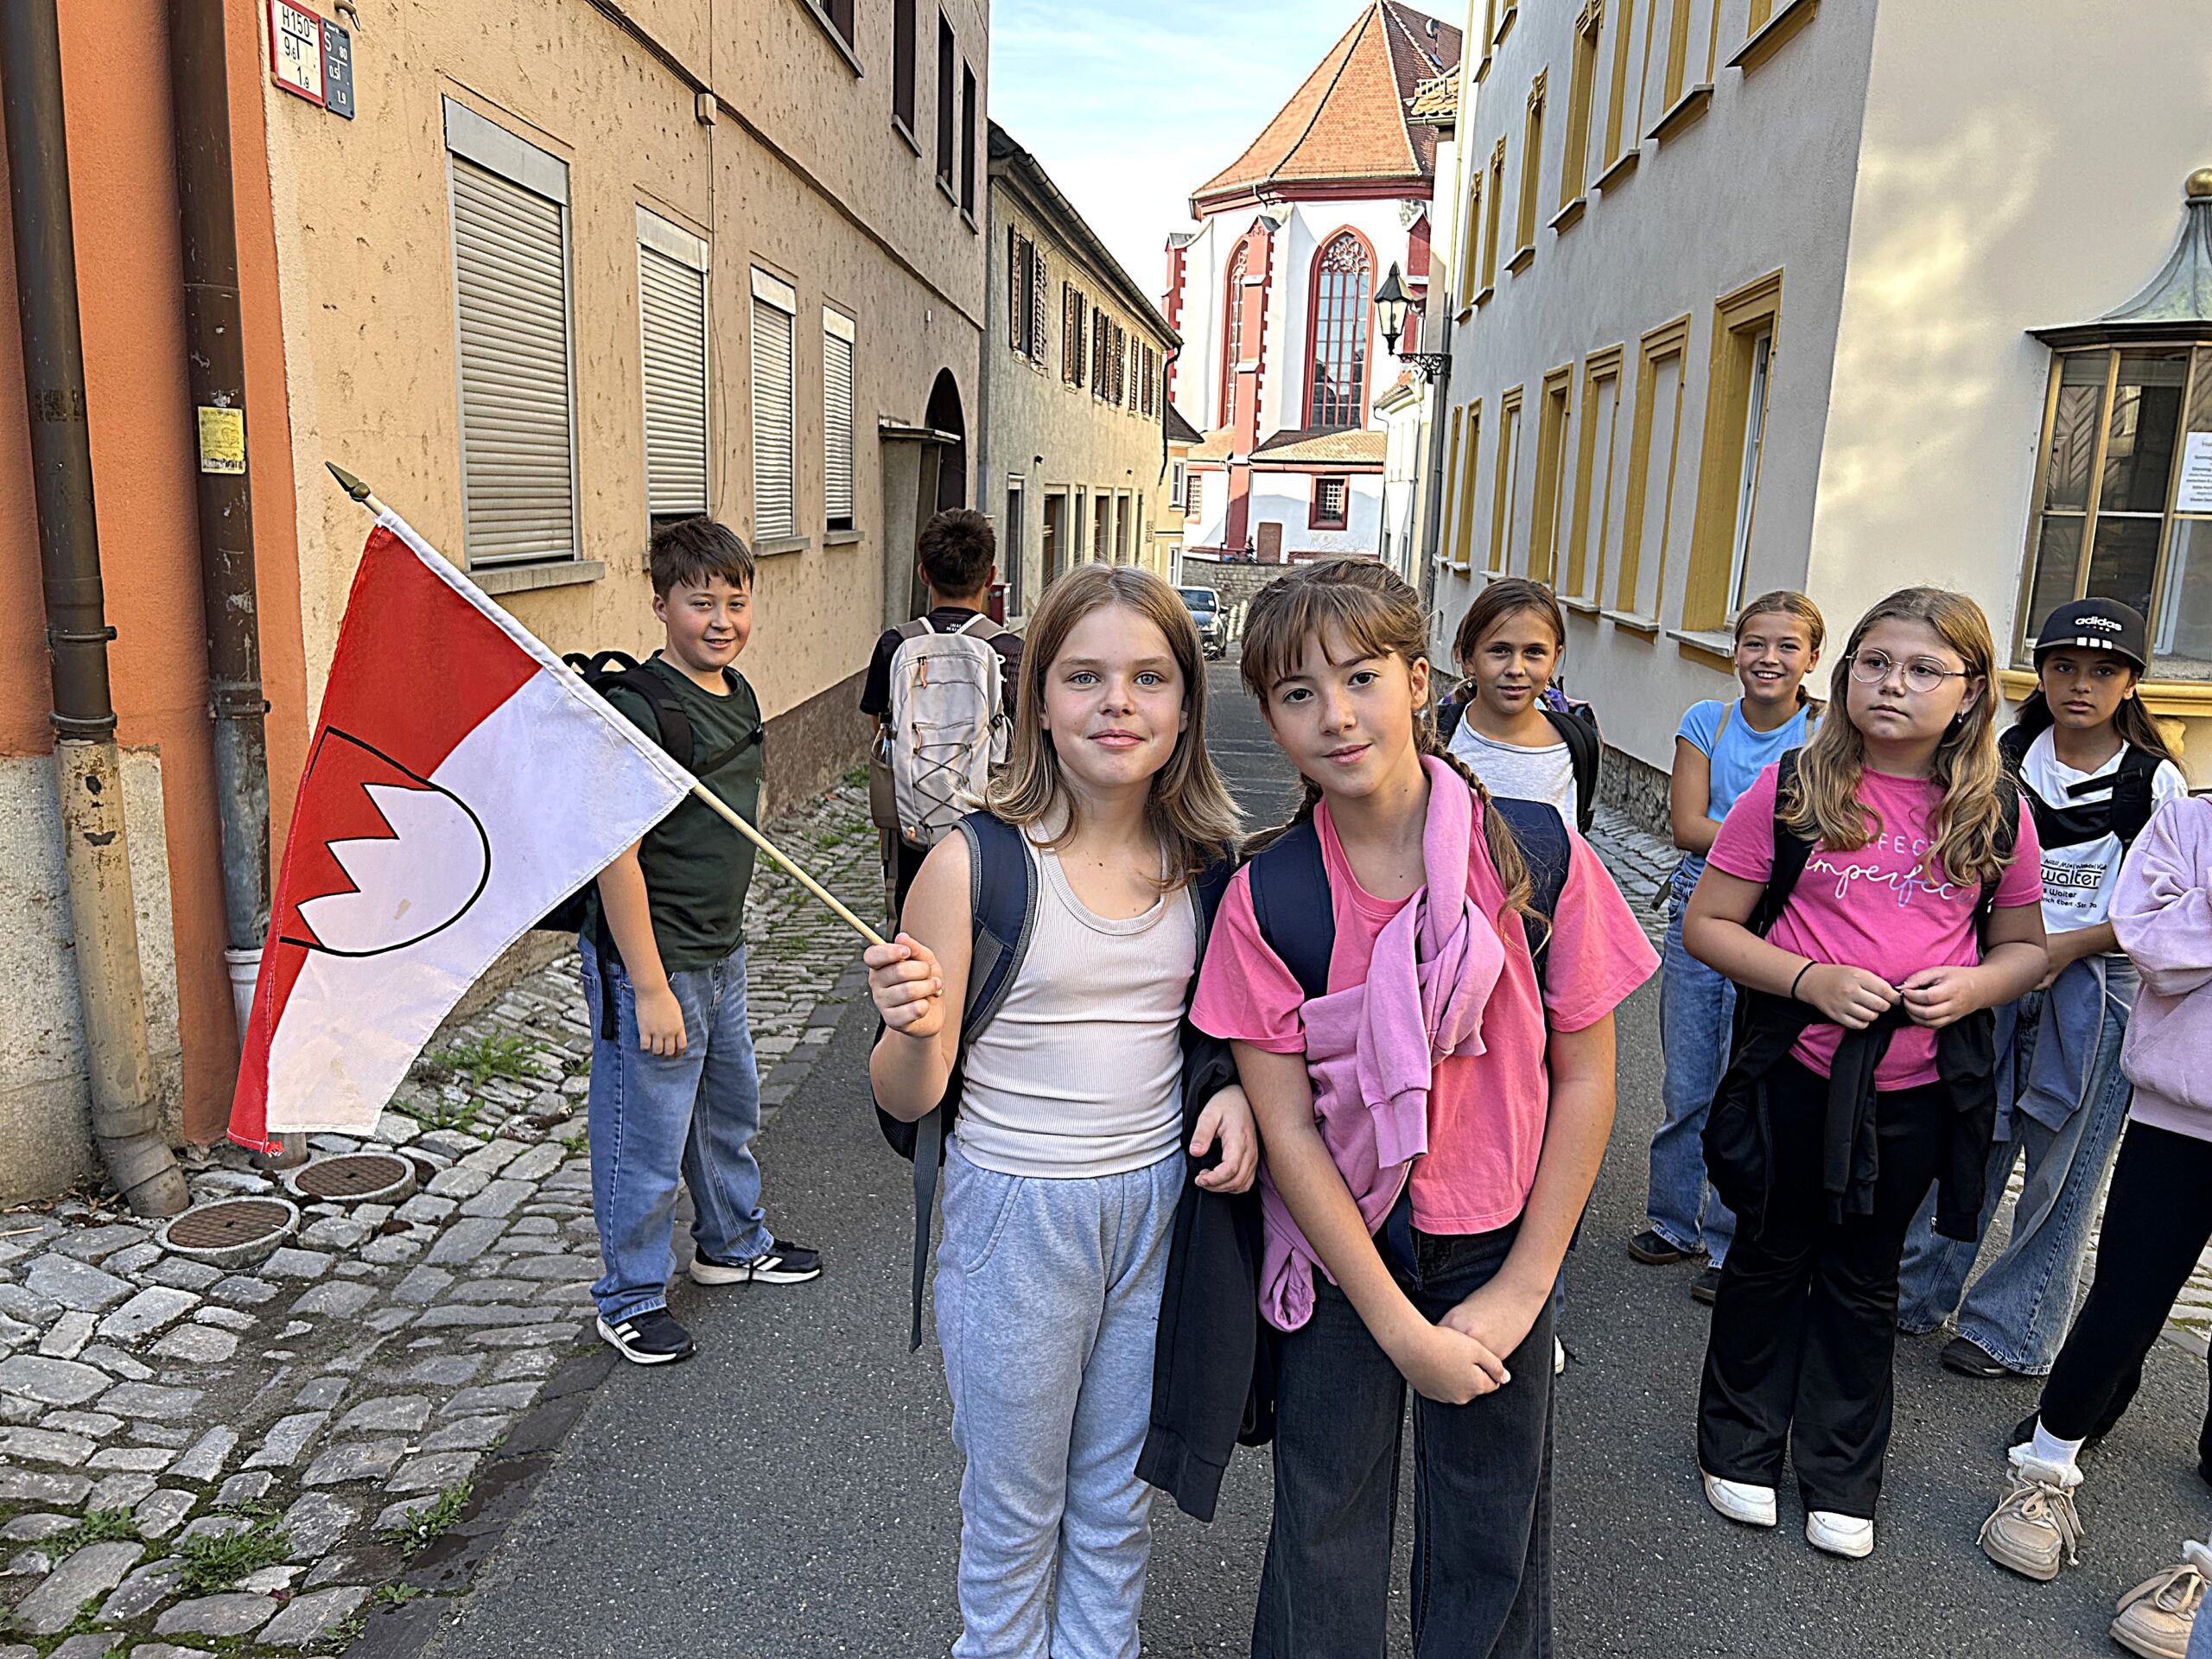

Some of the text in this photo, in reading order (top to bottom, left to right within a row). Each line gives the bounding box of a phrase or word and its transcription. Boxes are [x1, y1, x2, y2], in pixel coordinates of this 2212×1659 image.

[282, 6, 310, 38] H150
[324, 31, 332, 53] S
[339, 46, 348, 61] 80
[2075, 616, 2122, 632] adidas
[2040, 868, 2101, 887] walter
